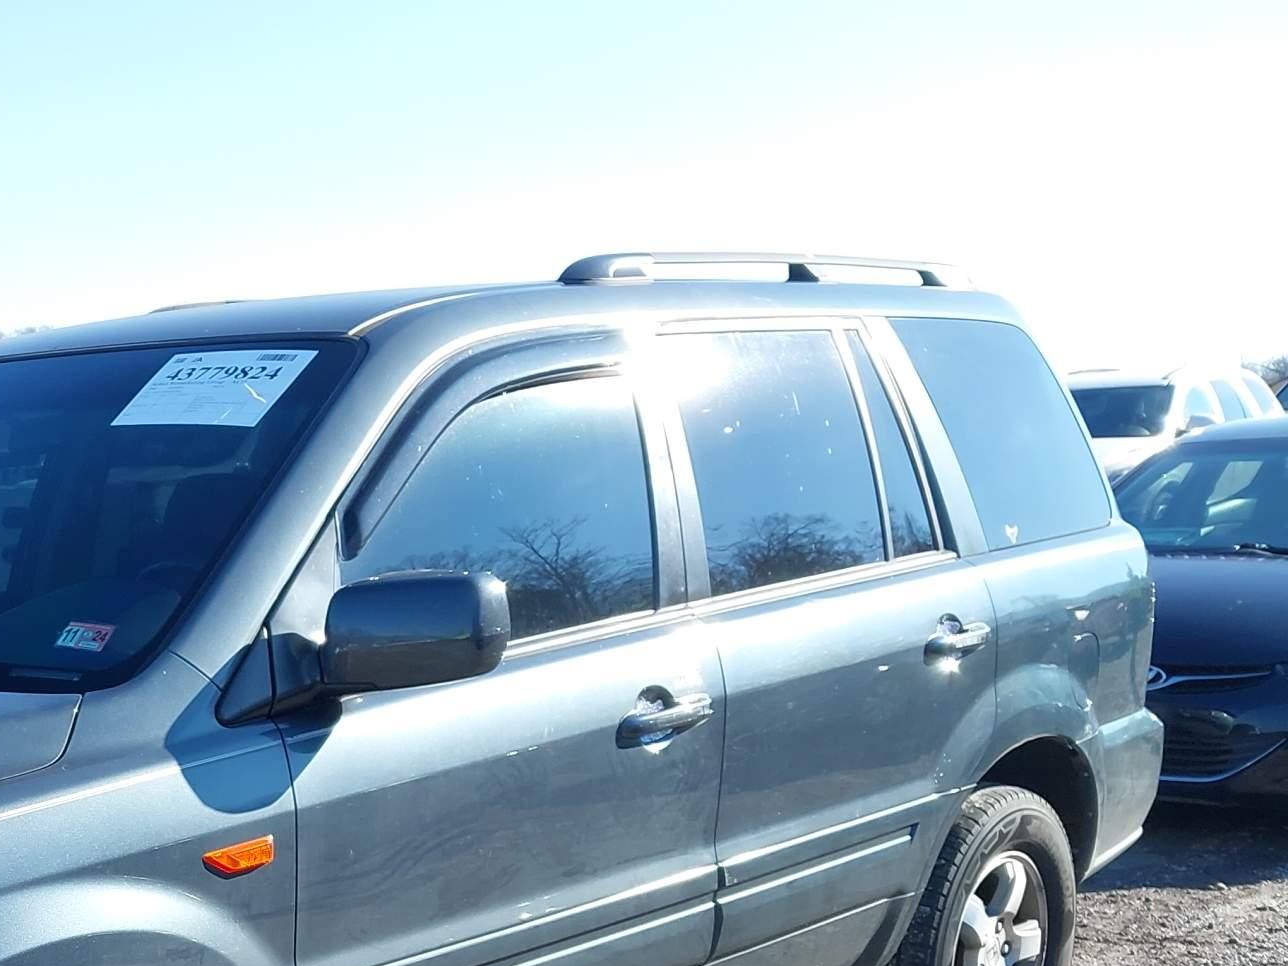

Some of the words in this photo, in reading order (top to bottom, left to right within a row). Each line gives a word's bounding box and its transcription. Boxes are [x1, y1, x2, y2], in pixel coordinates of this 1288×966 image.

[166, 366, 283, 380] 43779824
[64, 628, 80, 642] 11
[93, 630, 109, 642] 24
